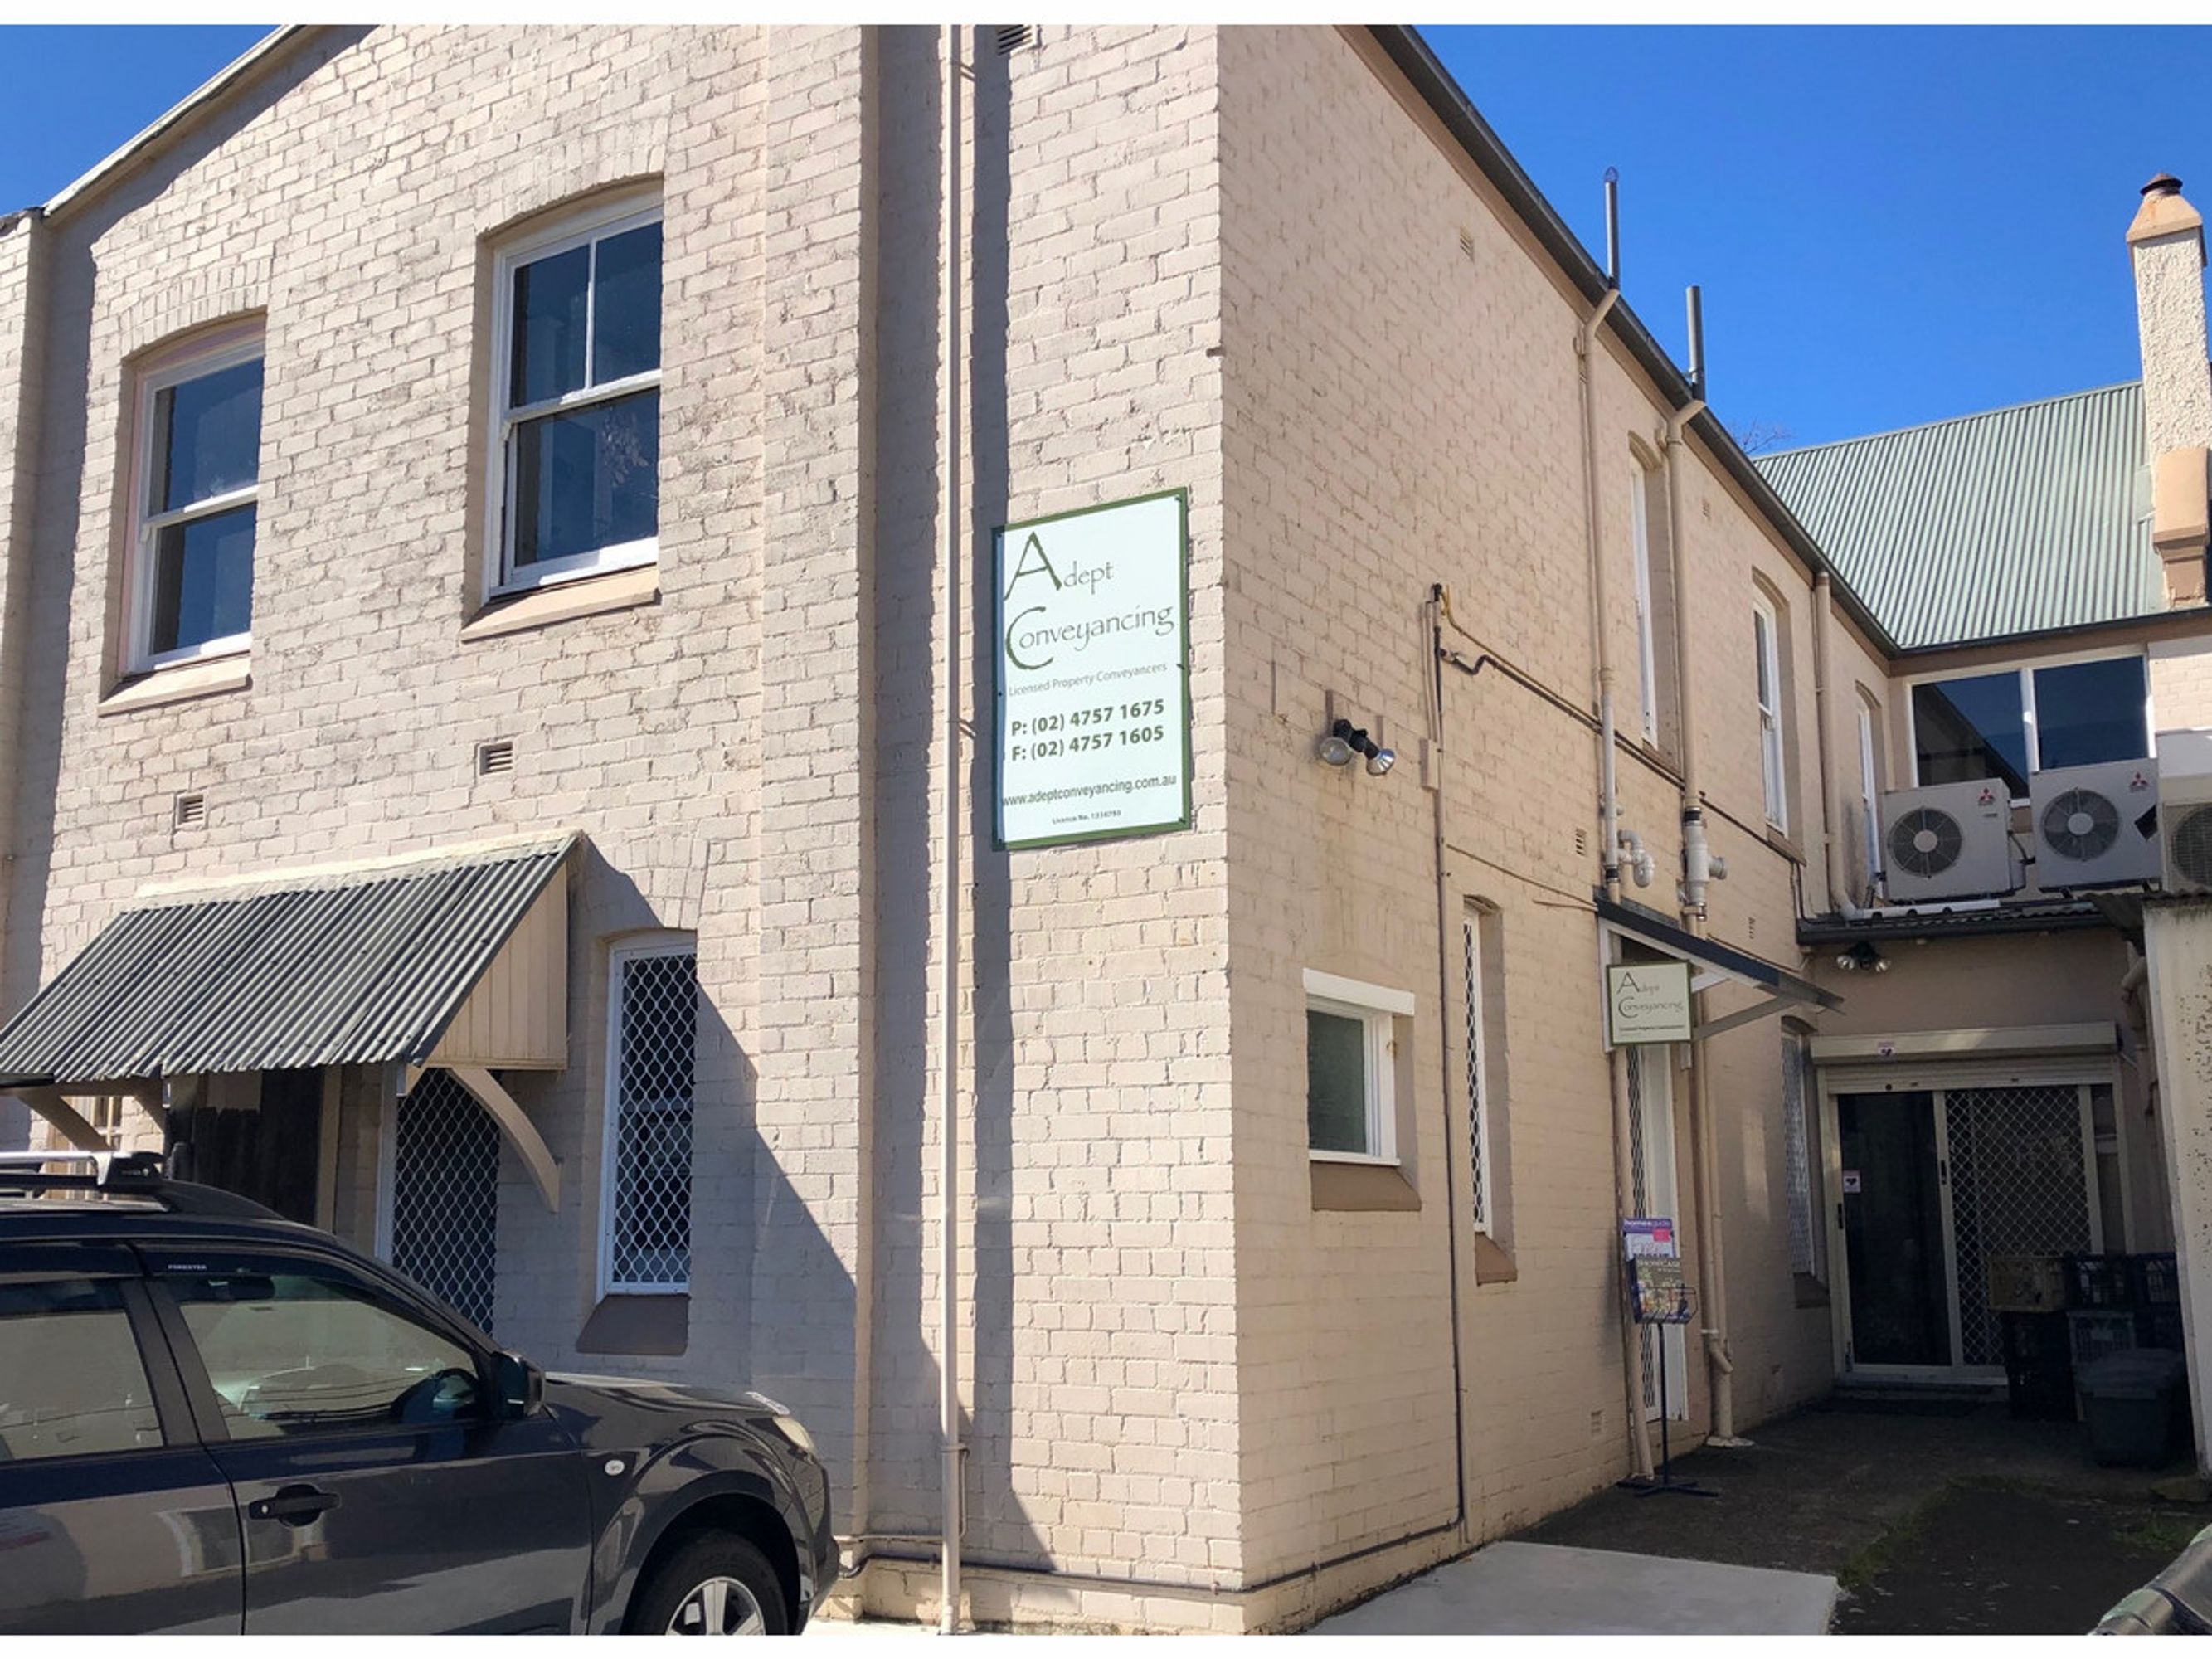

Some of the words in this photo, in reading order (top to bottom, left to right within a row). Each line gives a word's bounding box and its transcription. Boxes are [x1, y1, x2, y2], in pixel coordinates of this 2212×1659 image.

[1004, 532, 1114, 601] Adept
[1006, 606, 1175, 670] Conveyancing
[1009, 679, 1051, 697] Licensed
[1053, 674, 1095, 690] Property
[1096, 663, 1168, 683] Conveyancers
[1011, 720, 1028, 737] P:
[1032, 713, 1065, 736] (02)
[1069, 707, 1114, 727] 4757
[1121, 699, 1165, 719] 1675
[1011, 746, 1027, 761] F:
[1031, 739, 1064, 760] (02)
[1068, 732, 1113, 752] 4757
[1120, 725, 1164, 746] 1605
[1003, 774, 1177, 807] www.adeptconveyancing.com.au
